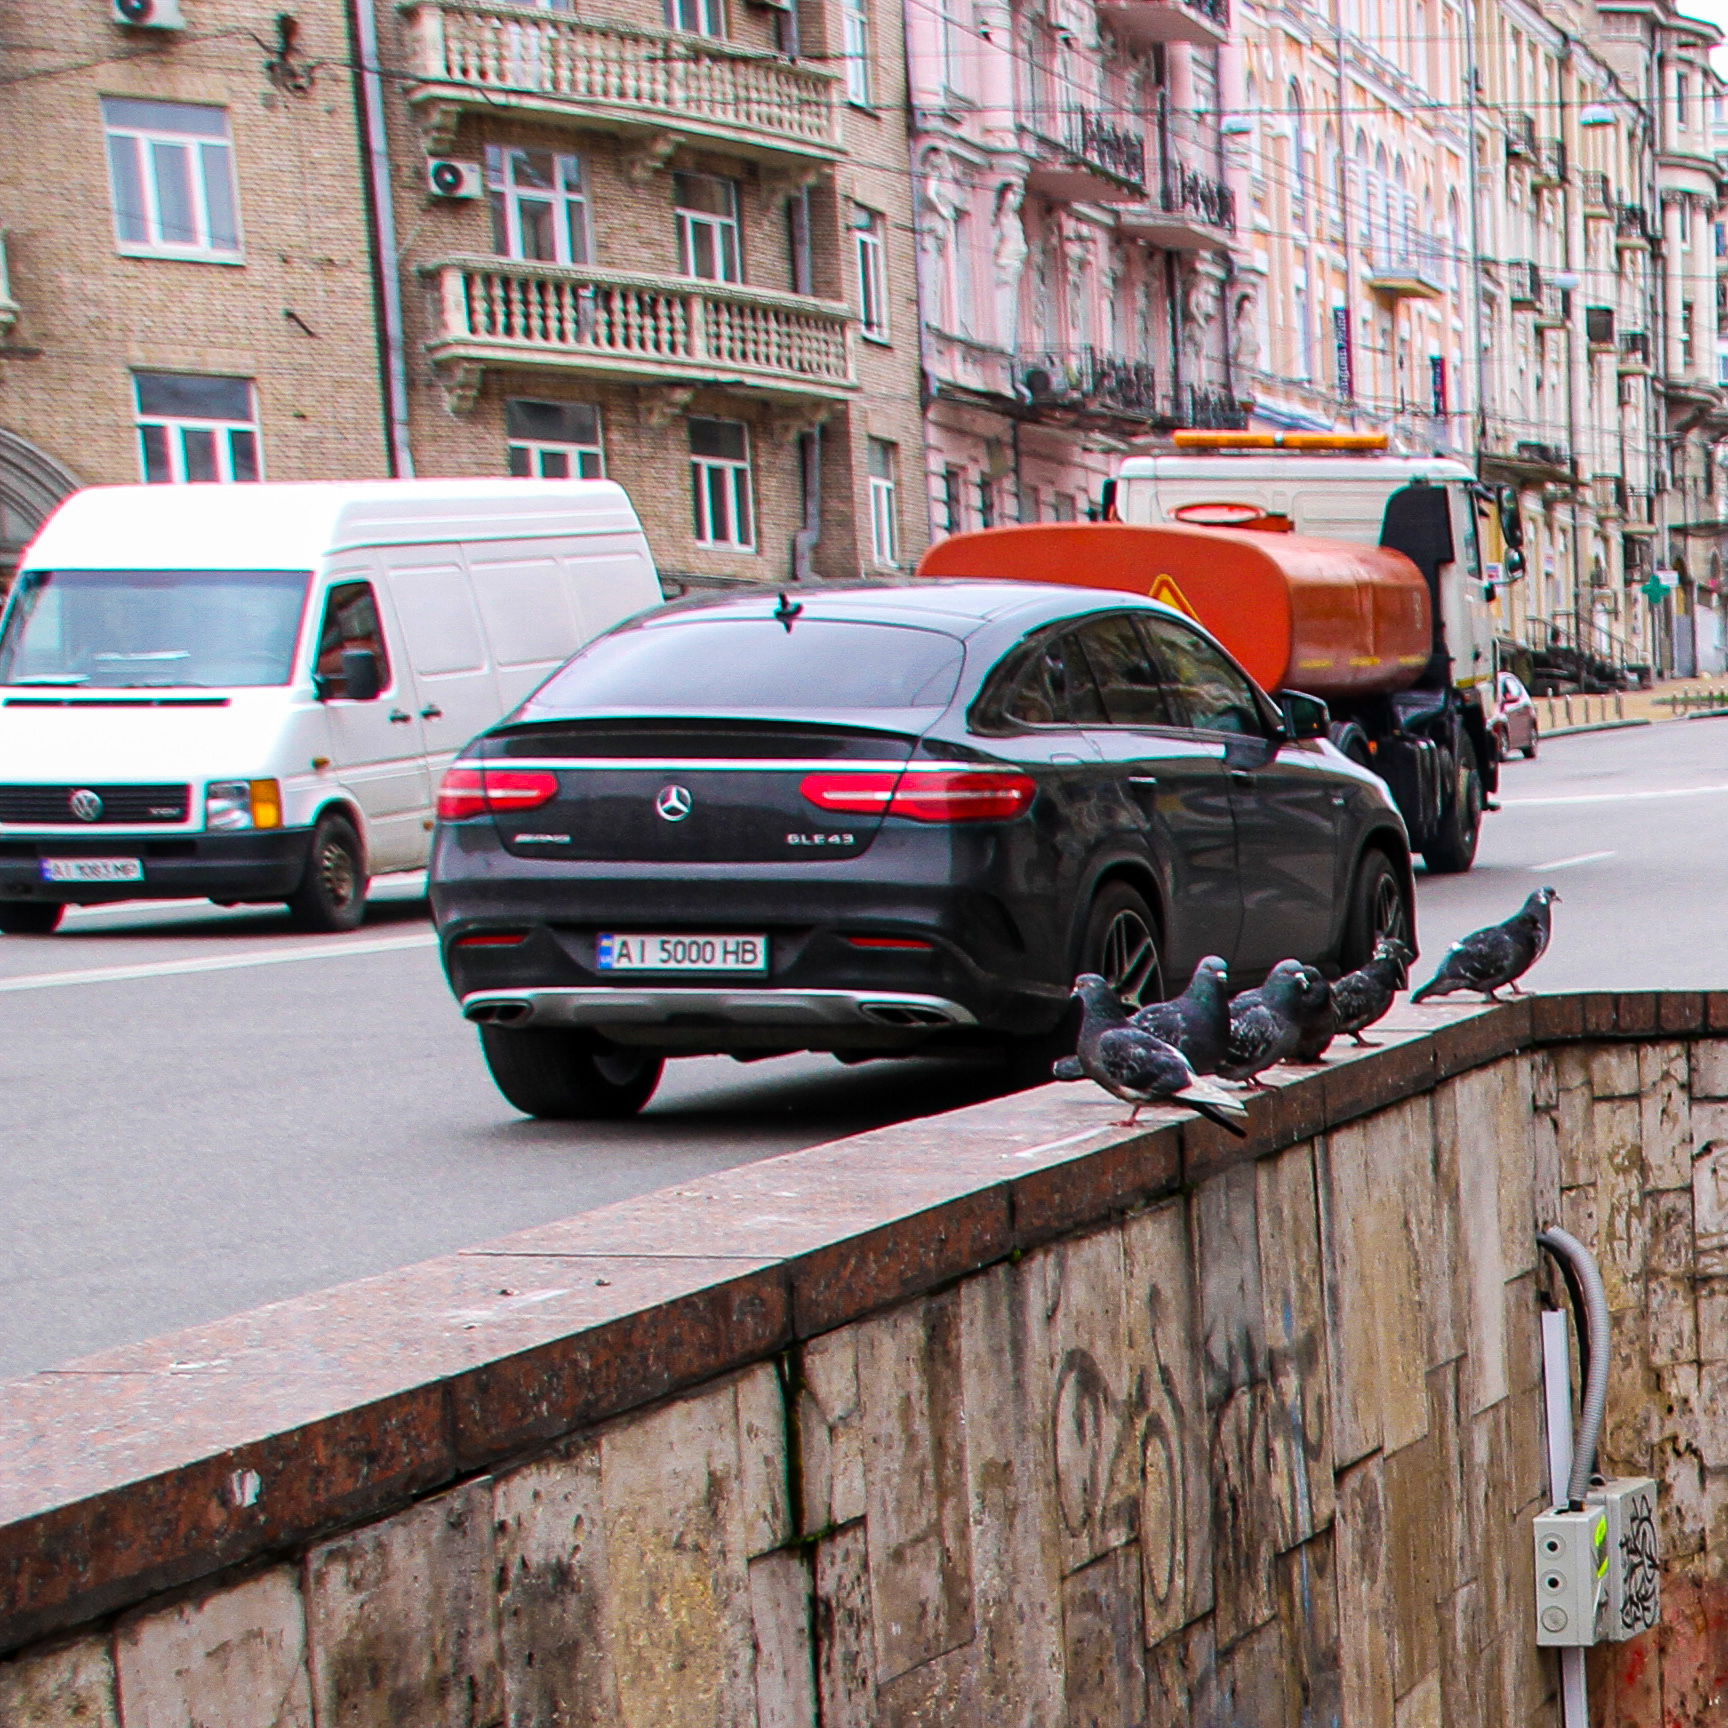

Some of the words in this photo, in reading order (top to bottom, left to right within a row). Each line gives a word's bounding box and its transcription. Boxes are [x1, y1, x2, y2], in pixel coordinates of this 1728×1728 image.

[786, 833, 825, 846] GLE
[827, 833, 855, 846] 43
[616, 939, 645, 964] AI
[659, 939, 715, 965] 5000
[723, 940, 759, 965] HB
